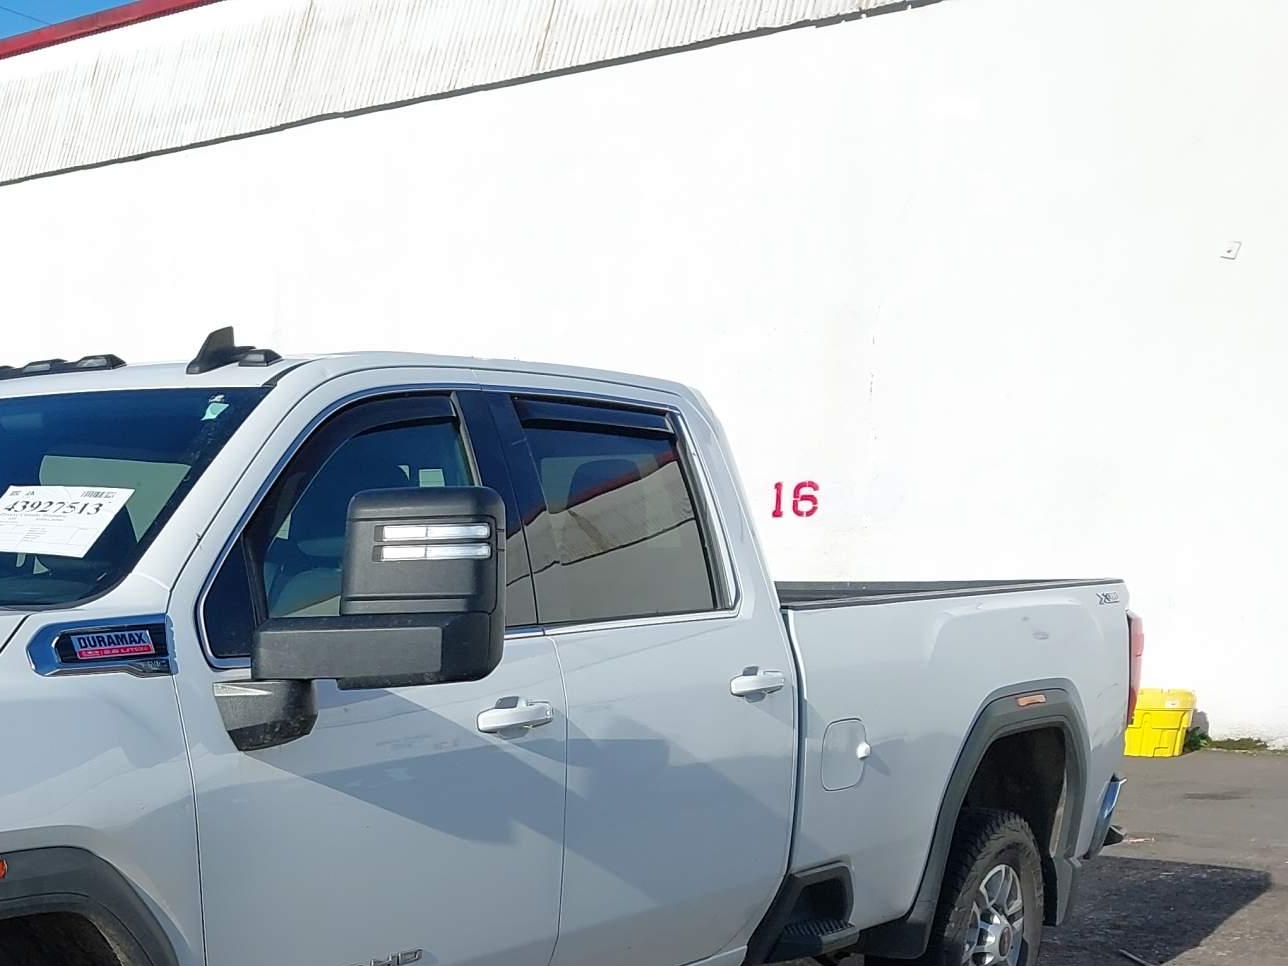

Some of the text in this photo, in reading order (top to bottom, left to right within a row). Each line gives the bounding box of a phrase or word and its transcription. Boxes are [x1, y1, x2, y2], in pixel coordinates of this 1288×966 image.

[772, 480, 819, 518] 16
[4, 500, 104, 516] 43927513
[78, 632, 146, 649] DURAMAX
